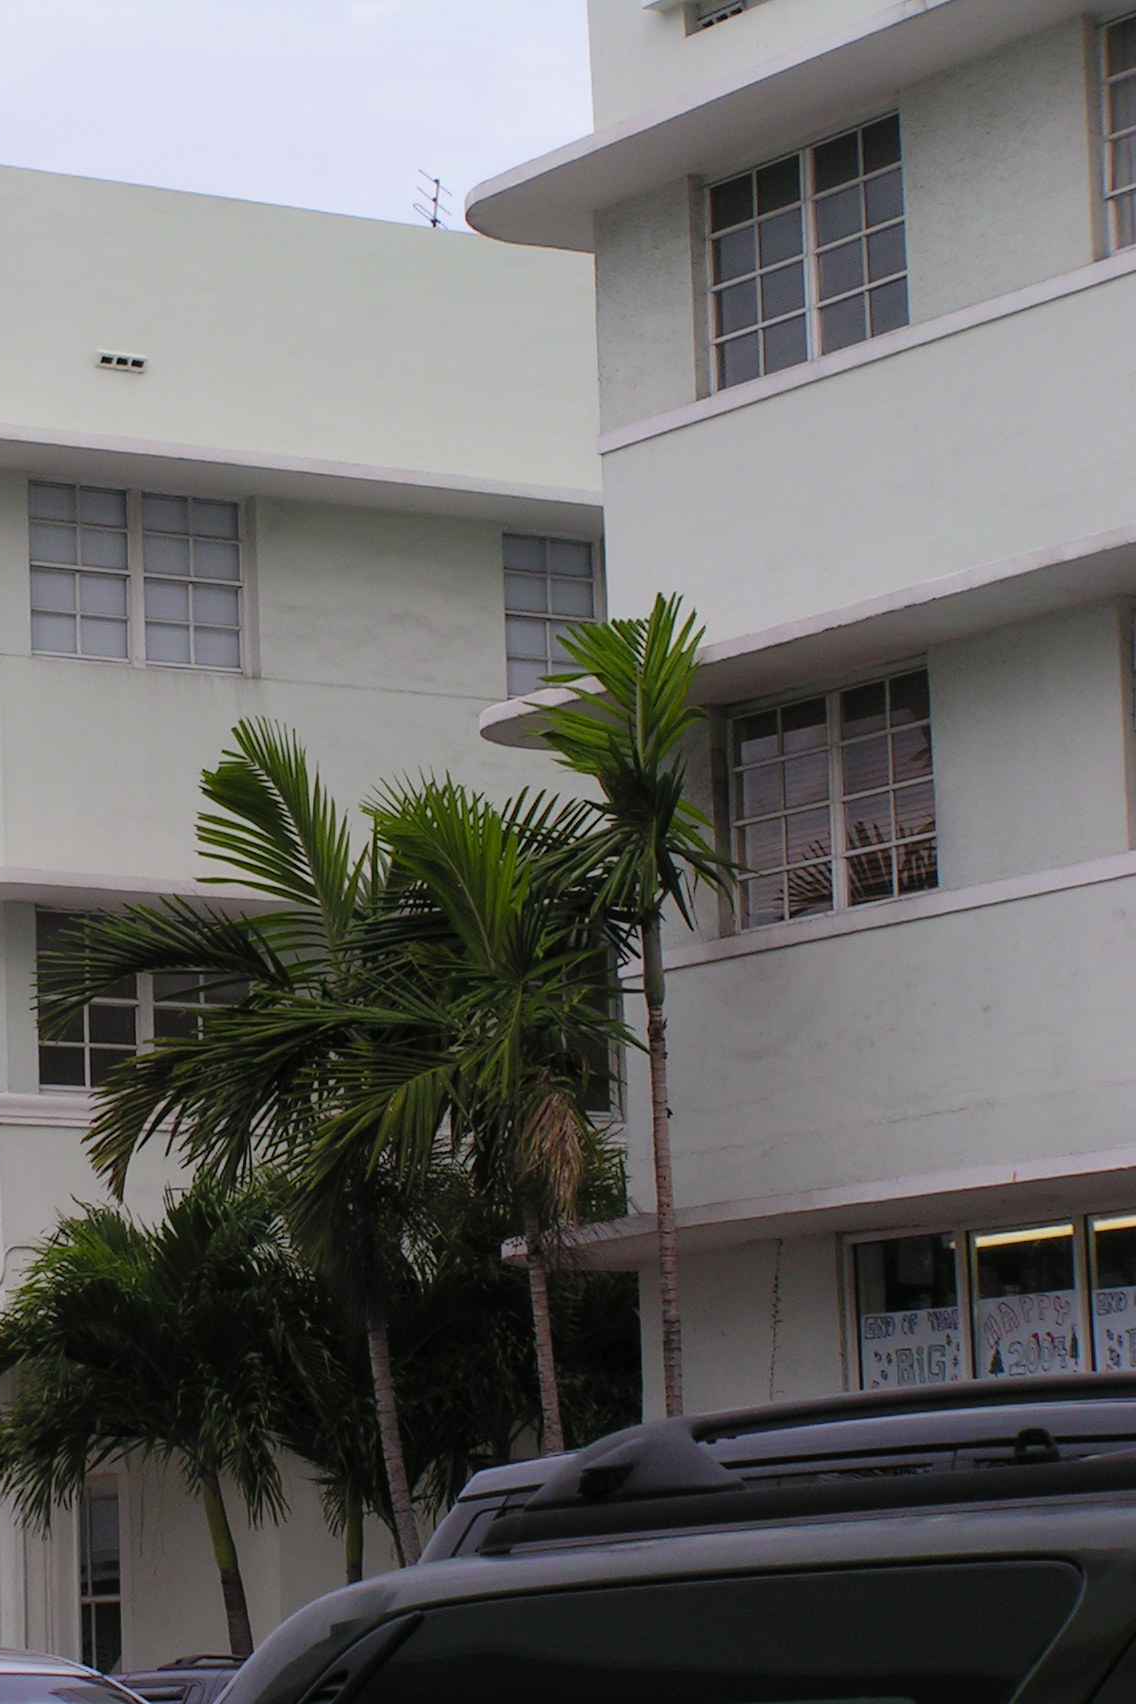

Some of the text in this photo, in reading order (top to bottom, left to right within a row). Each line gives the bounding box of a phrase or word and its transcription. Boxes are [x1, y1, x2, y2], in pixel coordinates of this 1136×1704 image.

[864, 1315, 896, 1340] END
[901, 1312, 918, 1335] OF
[983, 1294, 1071, 1349] HAPPY
